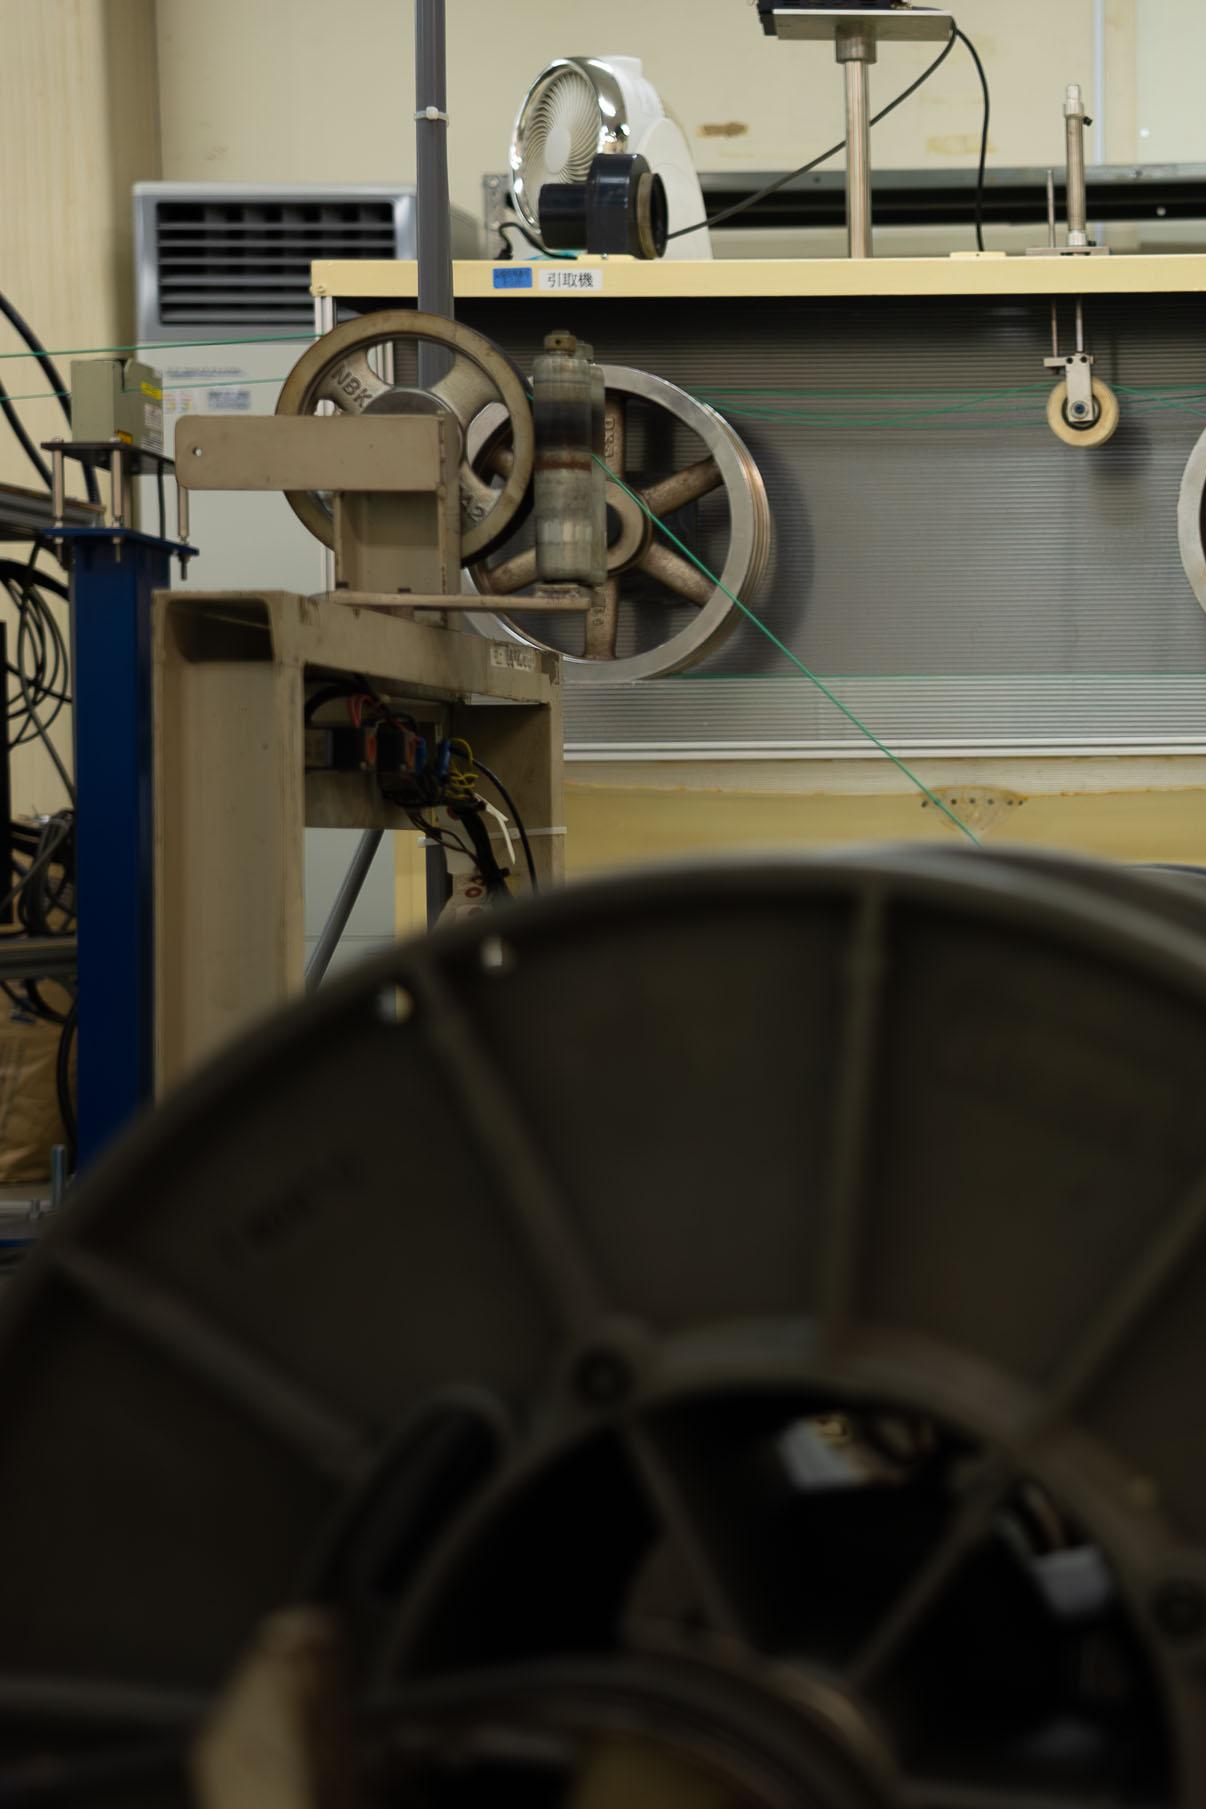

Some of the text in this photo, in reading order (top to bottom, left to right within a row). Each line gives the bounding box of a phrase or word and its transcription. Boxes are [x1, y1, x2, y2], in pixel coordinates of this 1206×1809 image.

[546, 271, 594, 289] 引取機
[331, 365, 373, 408] NBK
